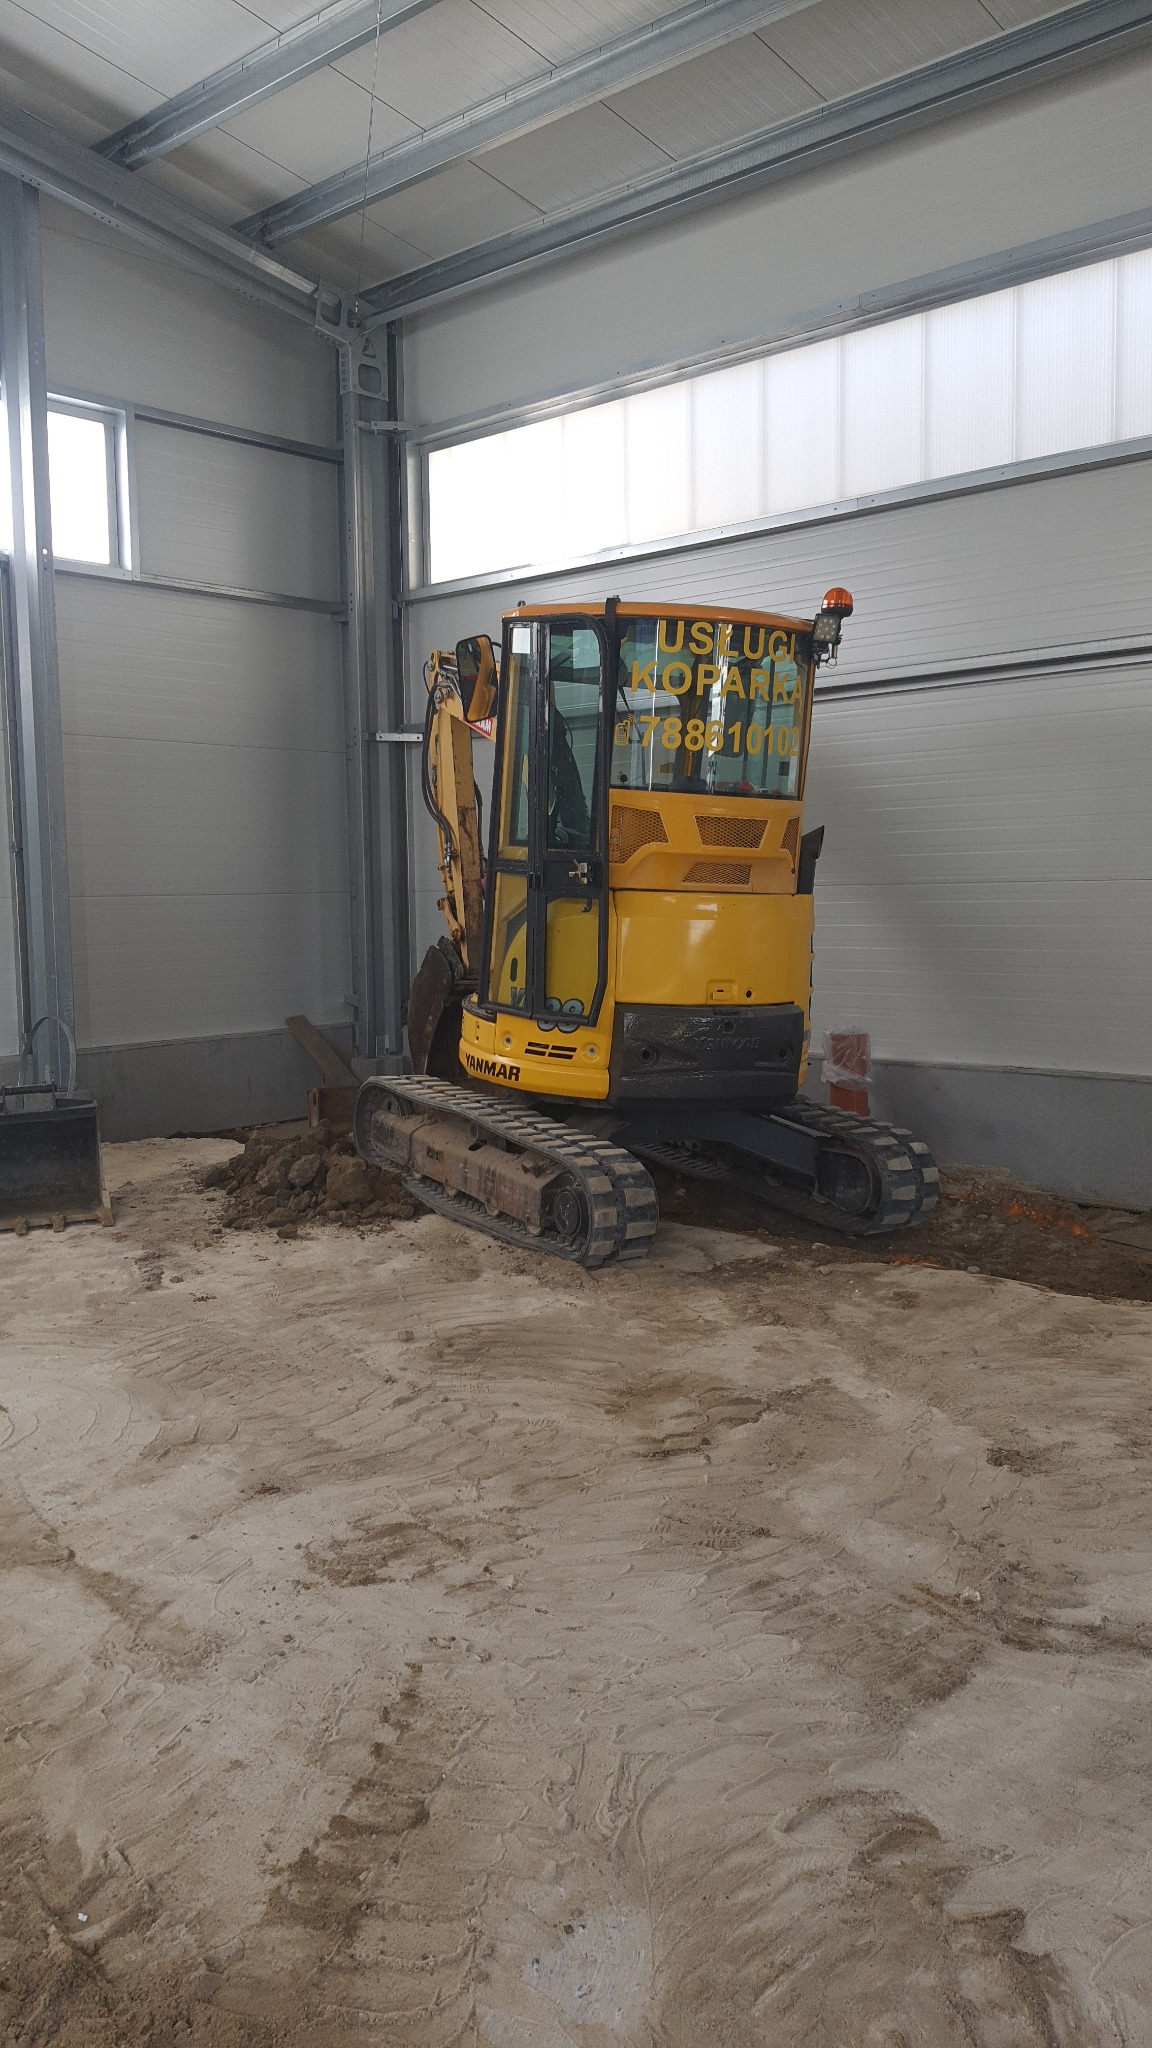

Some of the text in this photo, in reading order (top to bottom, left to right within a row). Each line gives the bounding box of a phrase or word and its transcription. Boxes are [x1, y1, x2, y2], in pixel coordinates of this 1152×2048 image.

[657, 619, 796, 665] USŁUGI
[631, 660, 803, 715] KOPARKA
[639, 715, 800, 757] 788610102
[465, 1052, 521, 1082] YANMAR
